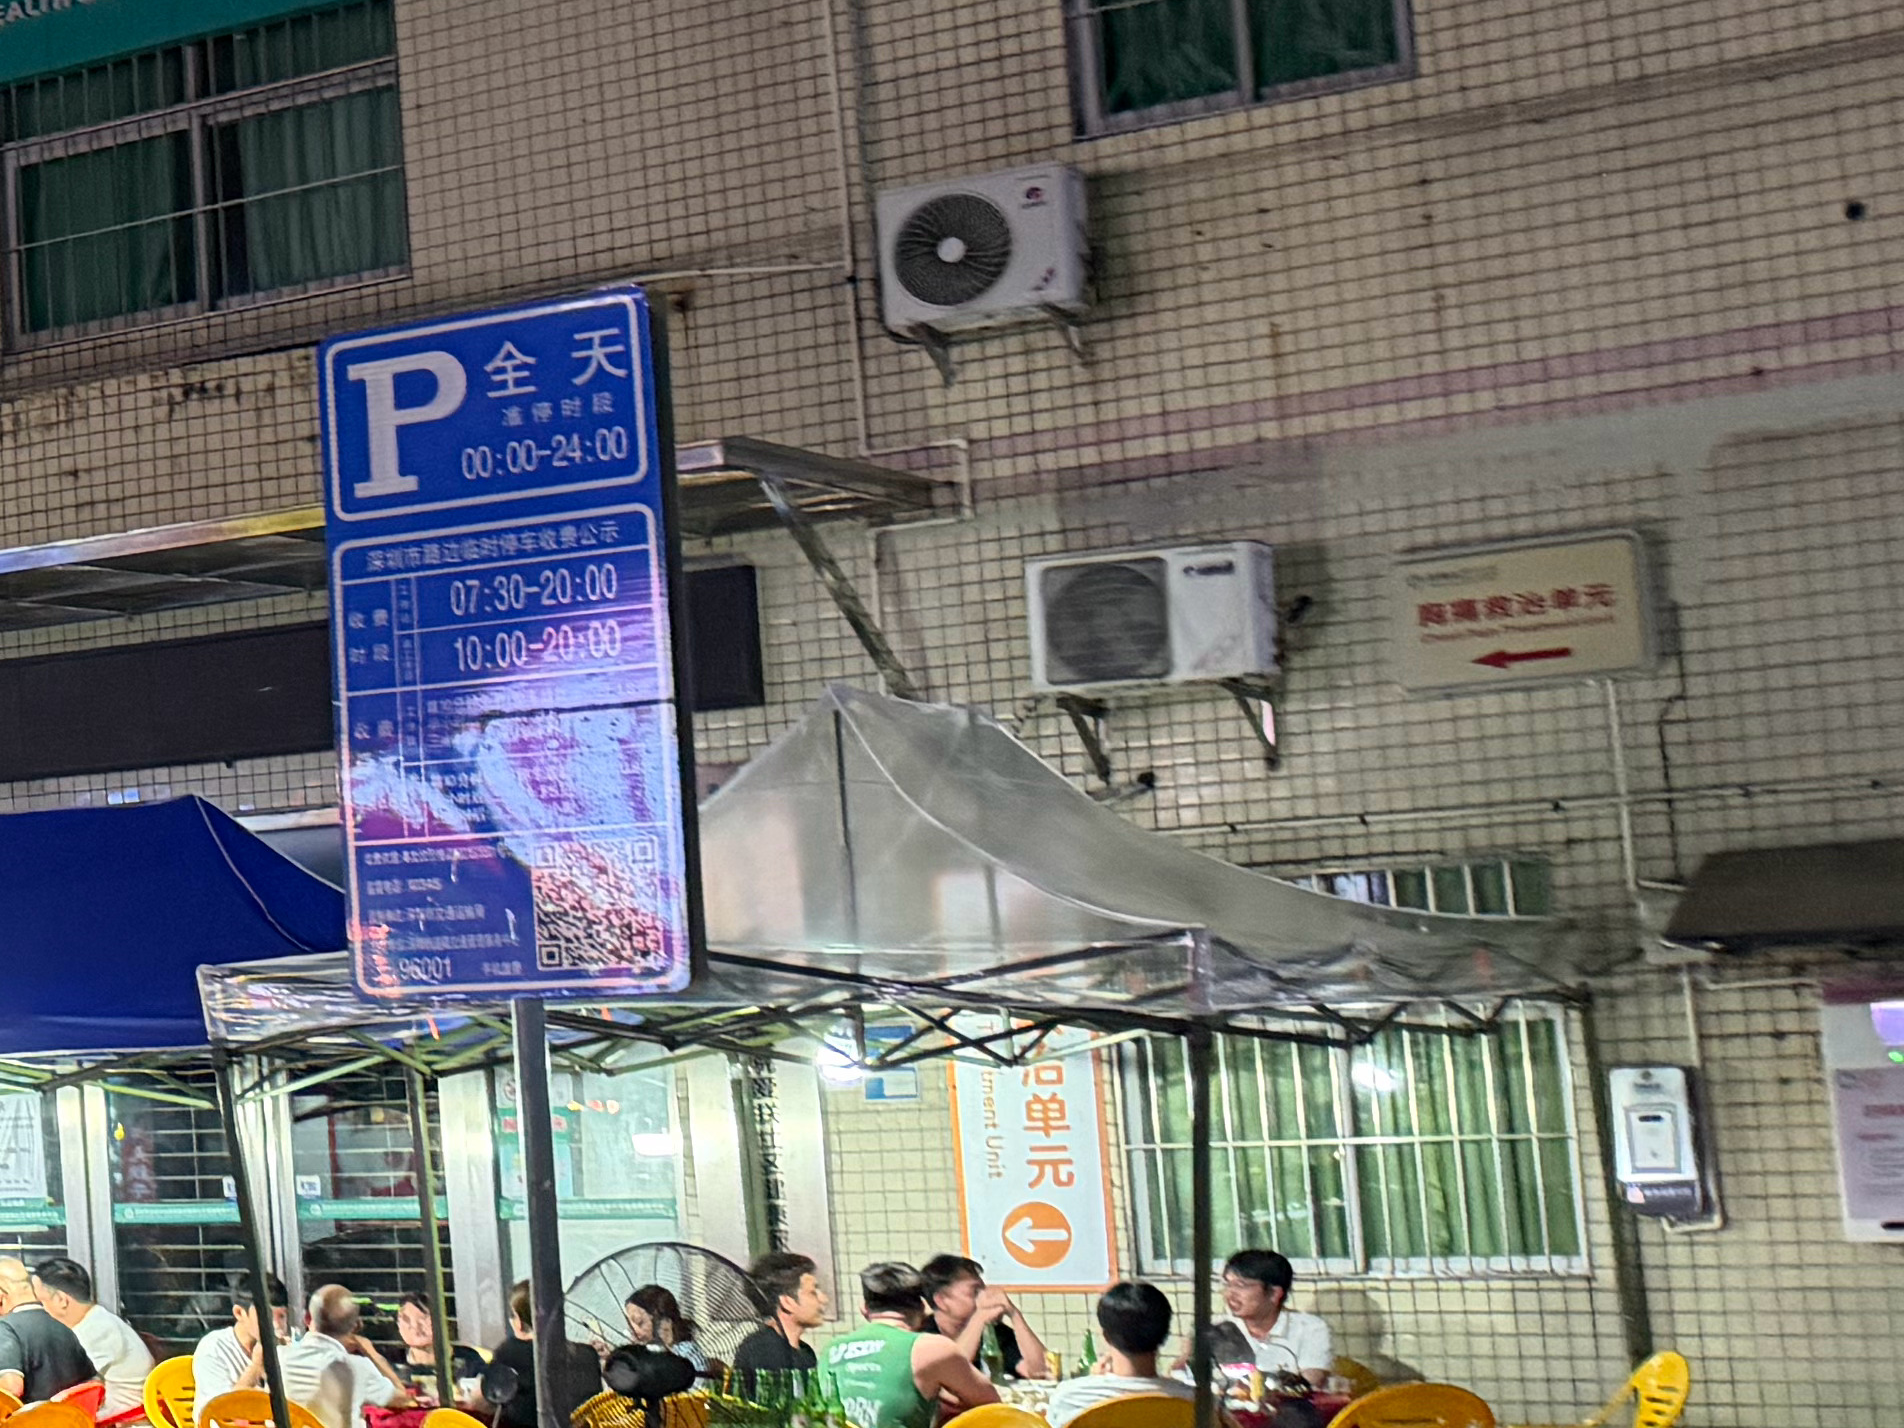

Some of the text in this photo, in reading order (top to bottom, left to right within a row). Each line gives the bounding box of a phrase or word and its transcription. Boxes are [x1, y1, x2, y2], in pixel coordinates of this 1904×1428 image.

[483, 327, 628, 399] 全天
[347, 350, 467, 498] P
[461, 425, 628, 480] 00:00-24:00
[450, 563, 618, 616] 07:30-20:00
[454, 620, 621, 673] 10:00-20:00
